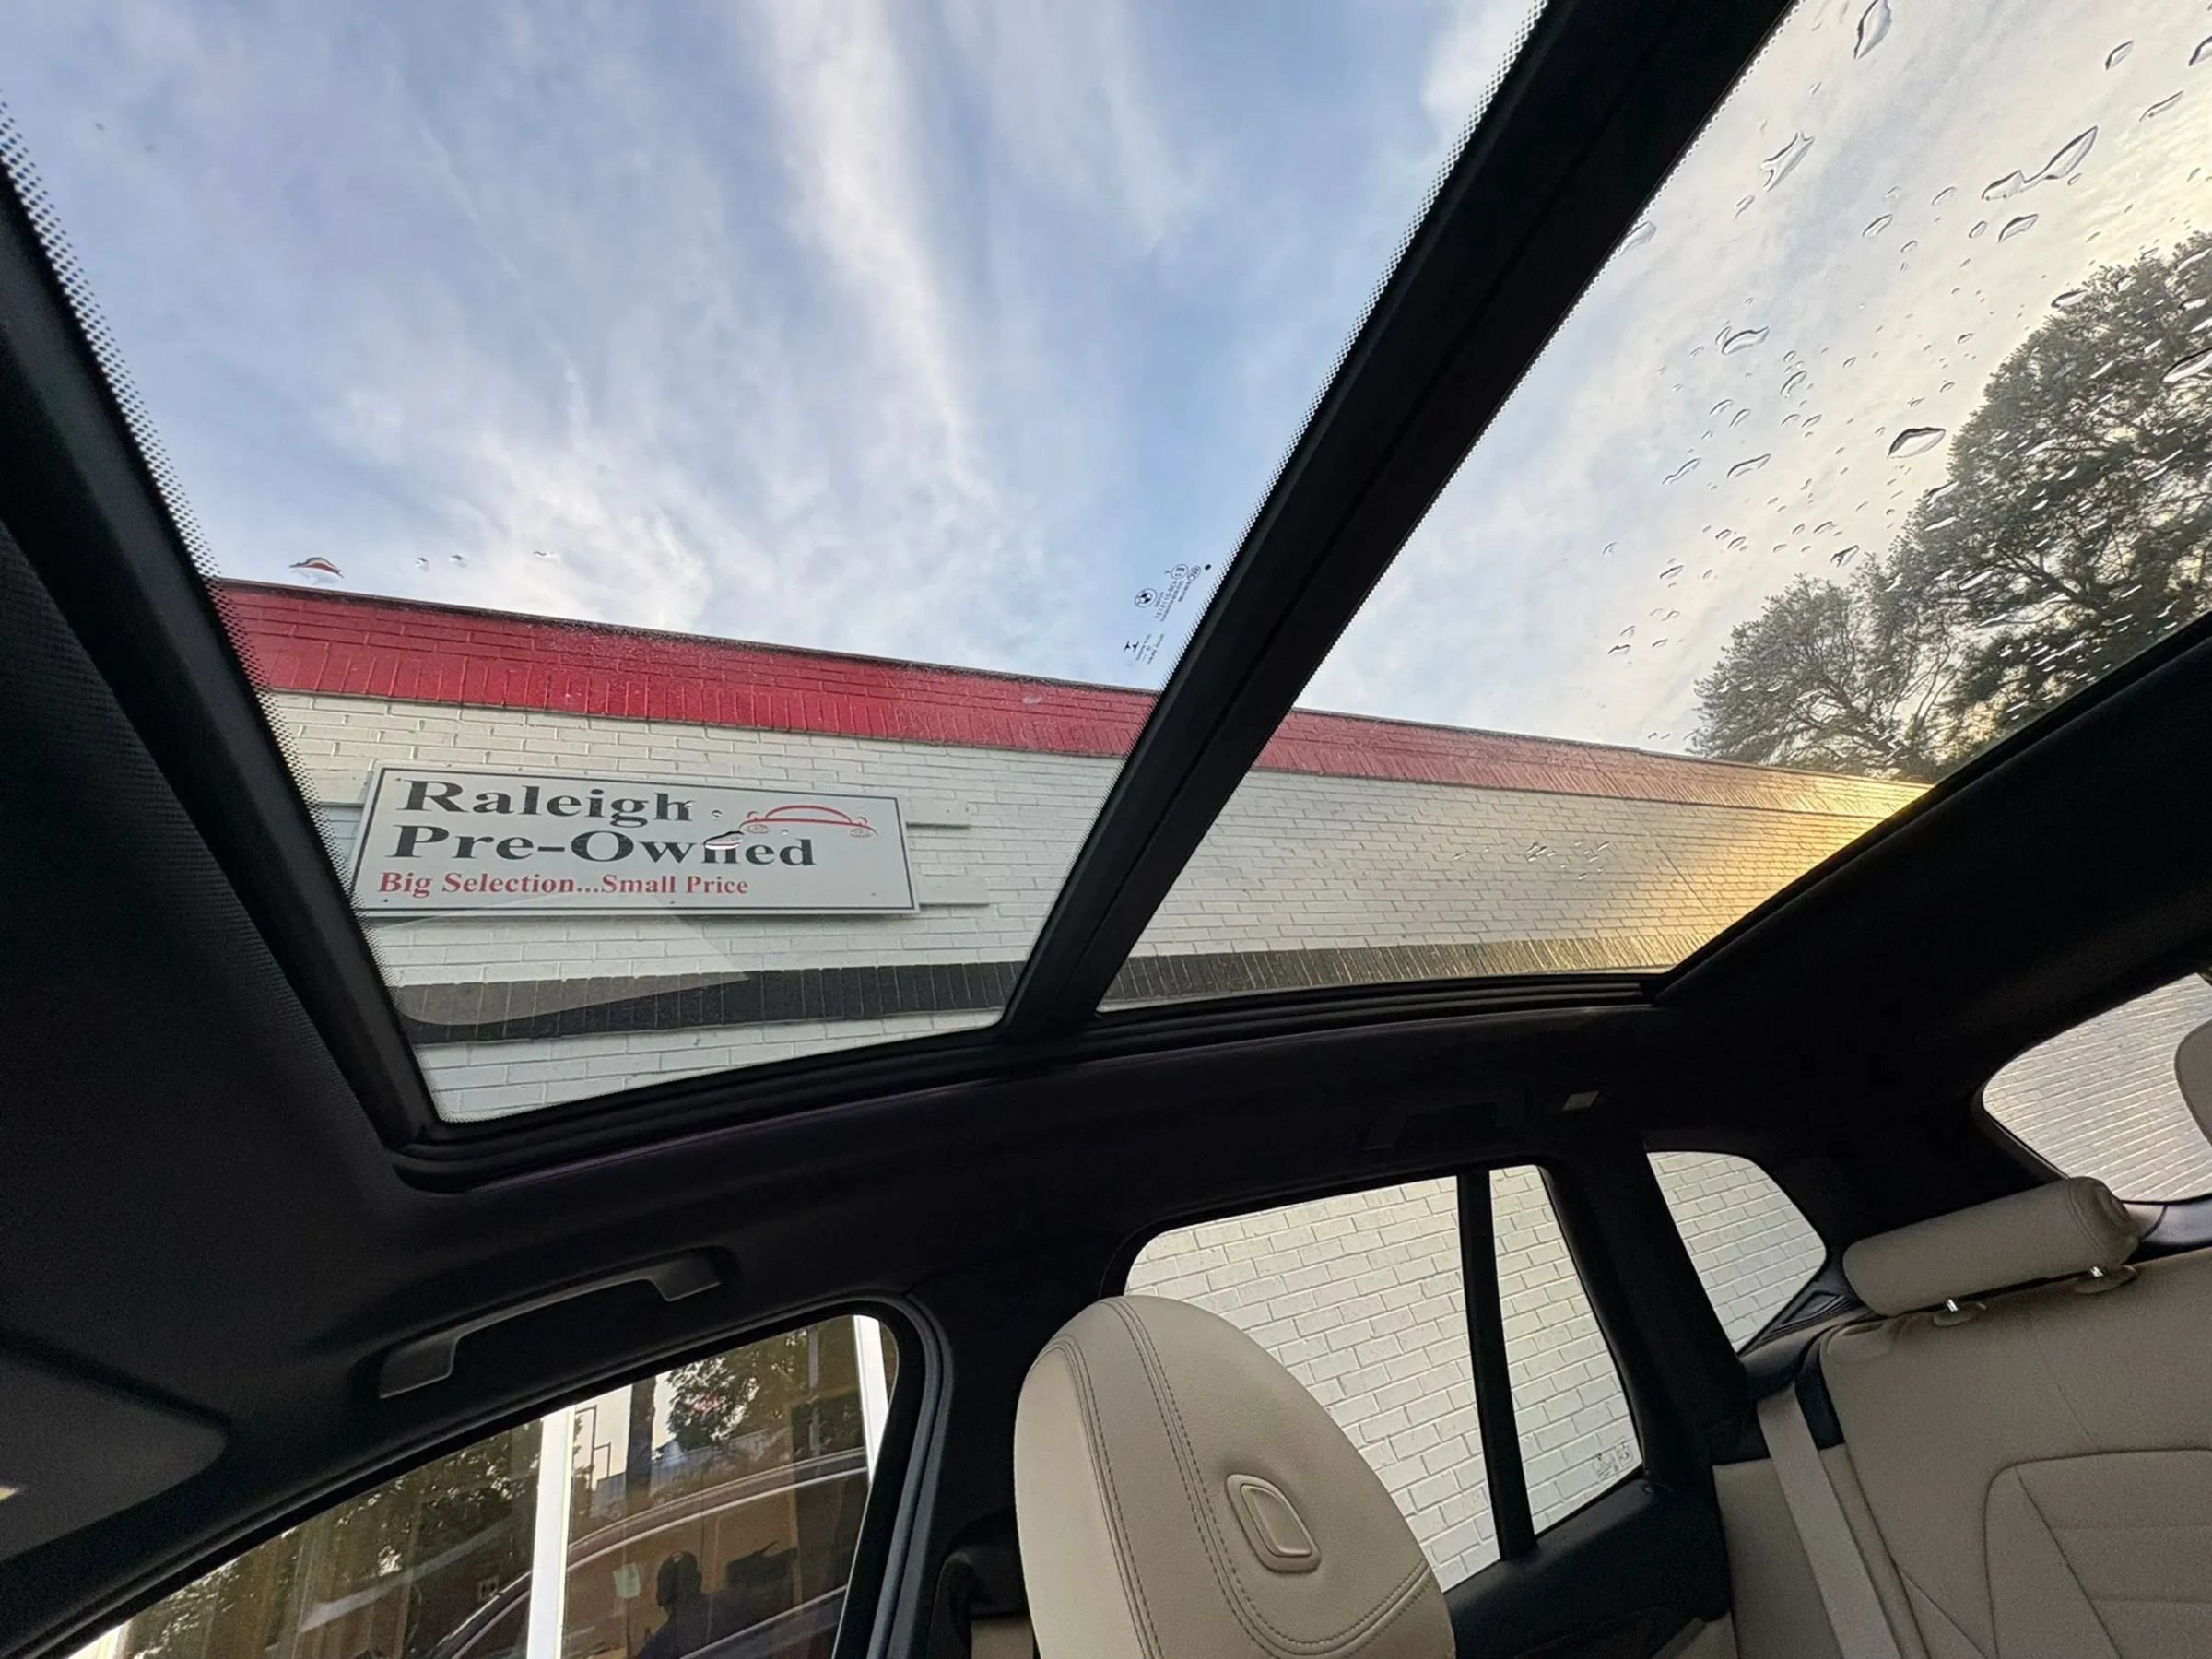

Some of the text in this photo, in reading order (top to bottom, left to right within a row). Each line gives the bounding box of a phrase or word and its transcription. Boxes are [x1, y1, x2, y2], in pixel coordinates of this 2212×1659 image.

[395, 779, 695, 828] Raleigh
[384, 824, 818, 866] Pre-Owned
[378, 872, 432, 898] Big
[687, 876, 748, 894] Price
